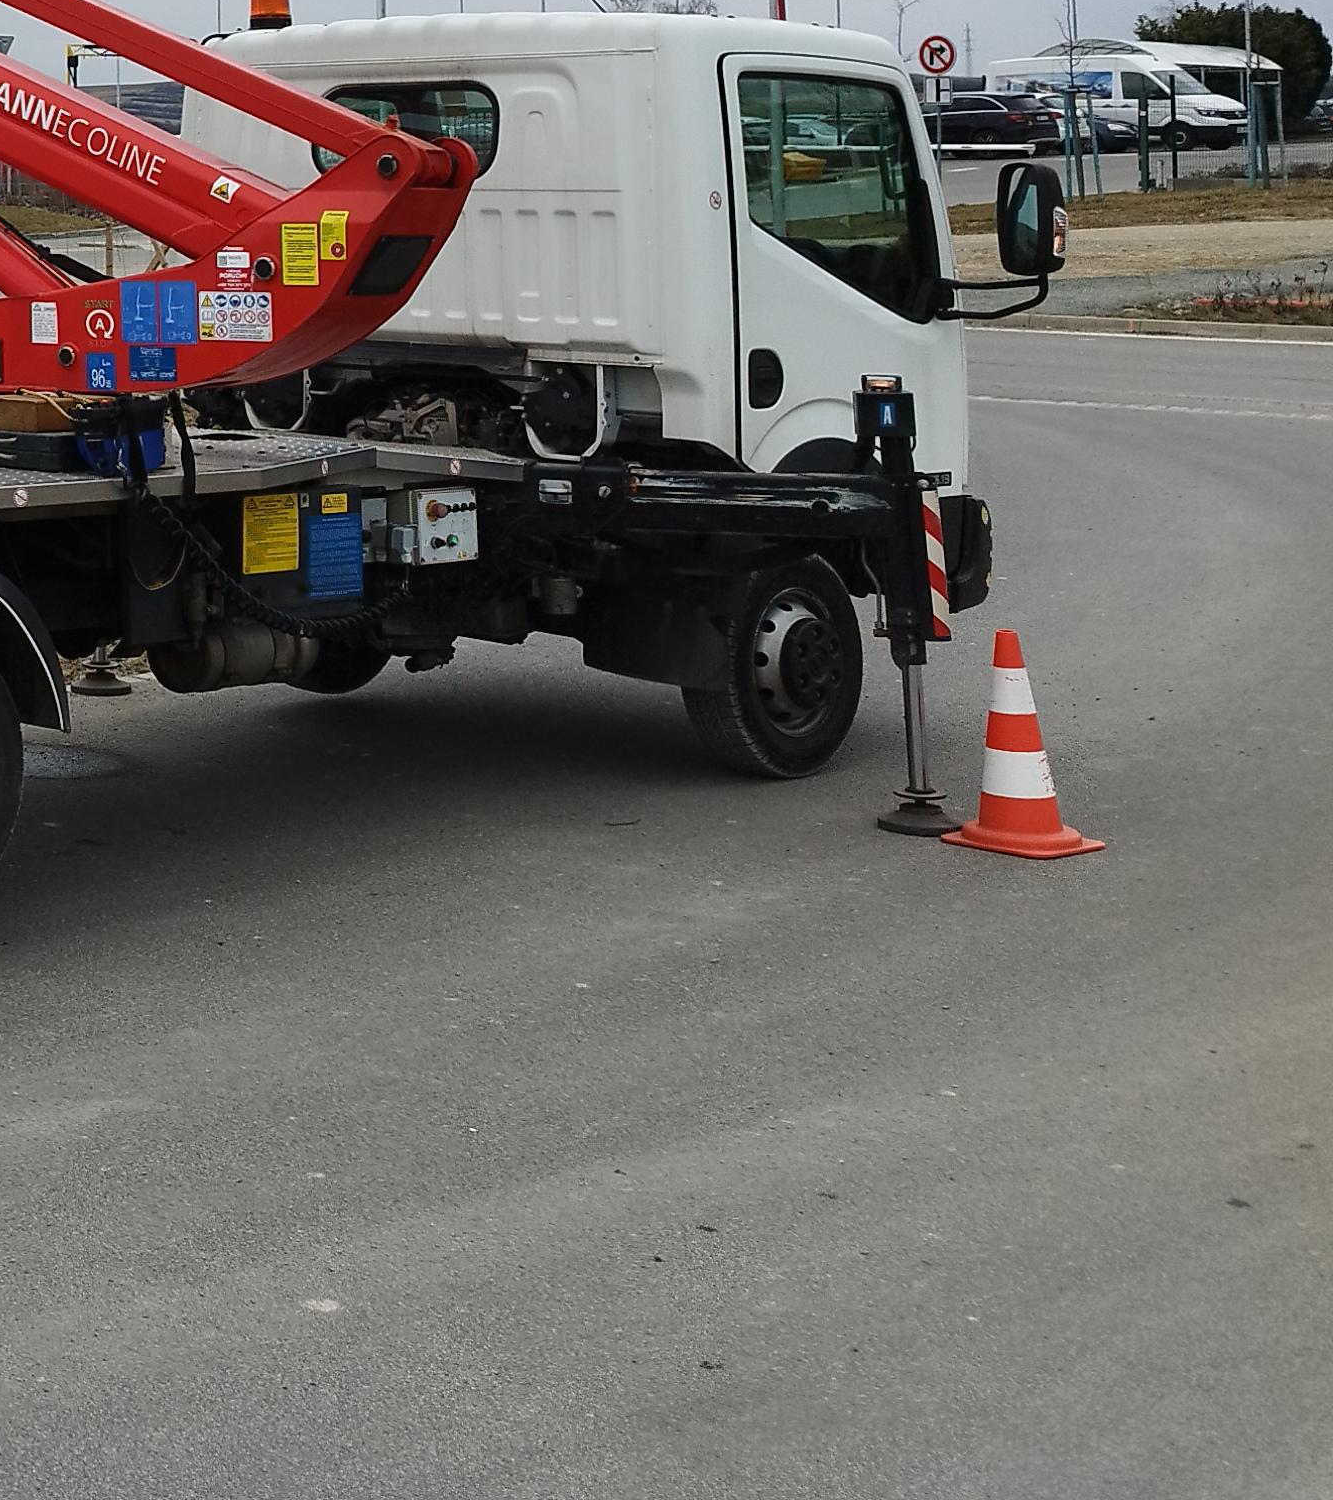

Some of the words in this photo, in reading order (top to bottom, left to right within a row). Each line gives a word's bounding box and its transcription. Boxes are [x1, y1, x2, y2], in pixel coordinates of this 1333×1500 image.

[95, 317, 105, 330] A
[92, 368, 106, 388] 96
[884, 405, 893, 425] A
